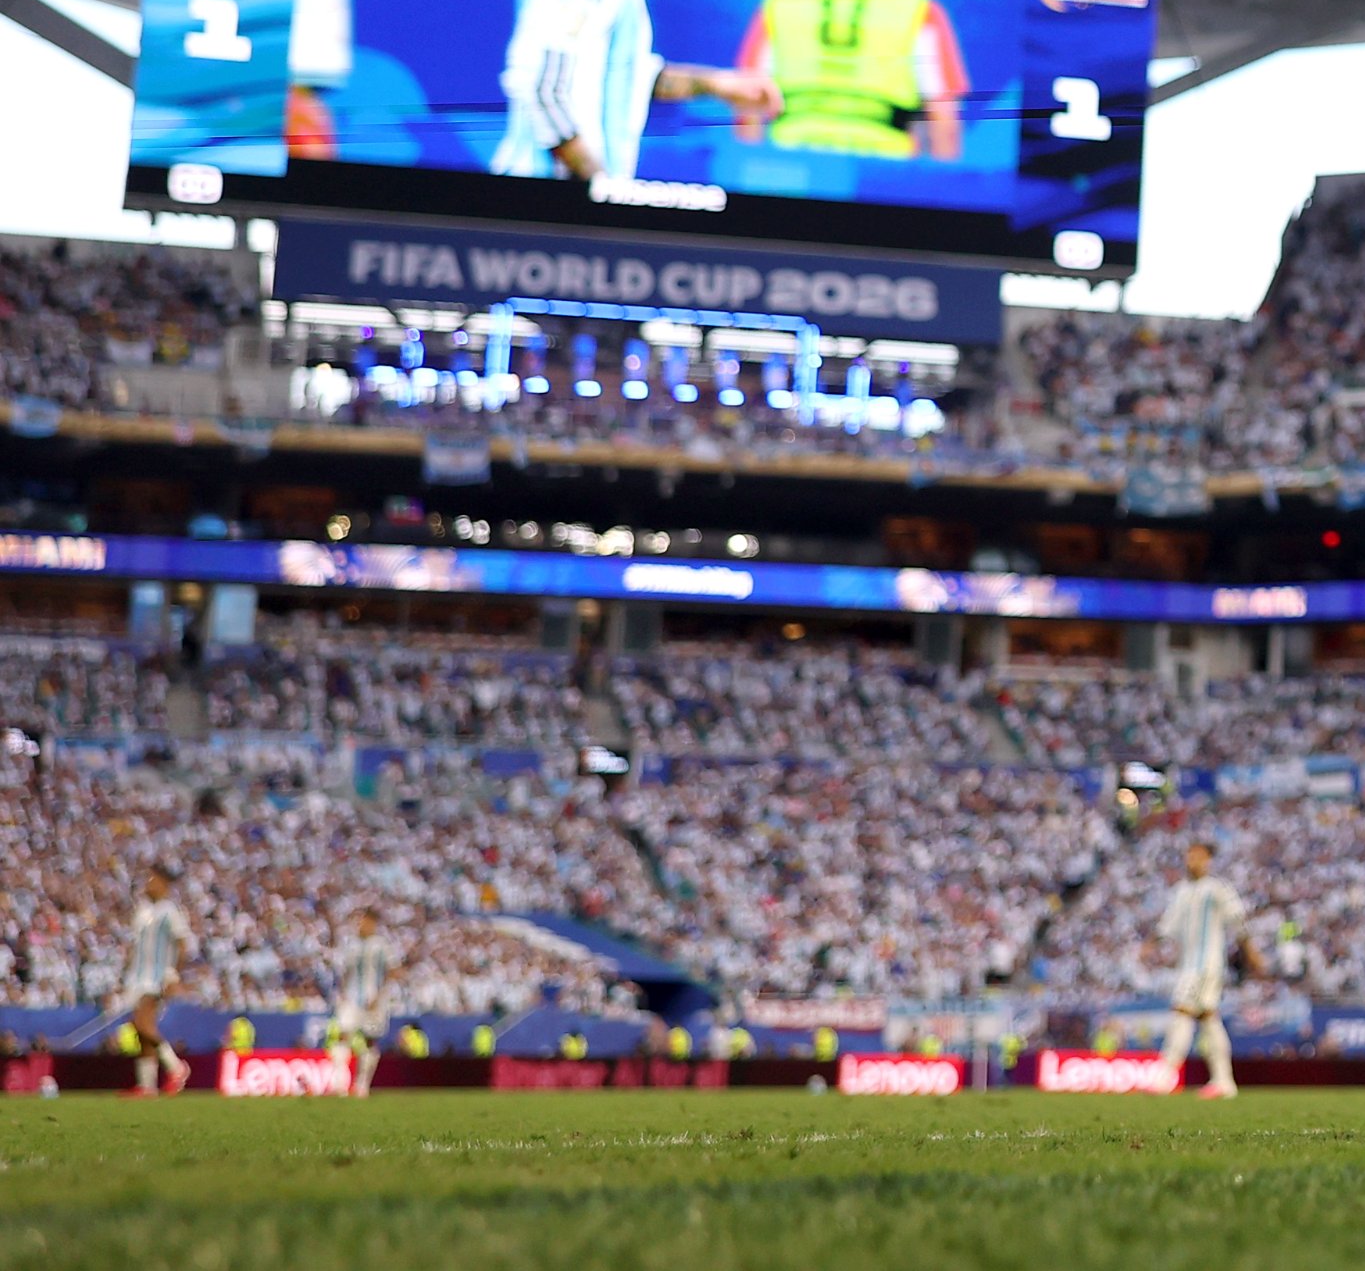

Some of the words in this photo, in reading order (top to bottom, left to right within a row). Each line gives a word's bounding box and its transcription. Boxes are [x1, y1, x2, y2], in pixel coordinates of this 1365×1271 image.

[1050, 76, 1111, 141] 1
[350, 241, 463, 289] FIFA
[469, 246, 655, 303] WORLD
[660, 262, 764, 309] CUP
[765, 269, 939, 321] 2026
[841, 1054, 959, 1096] Lenovo
